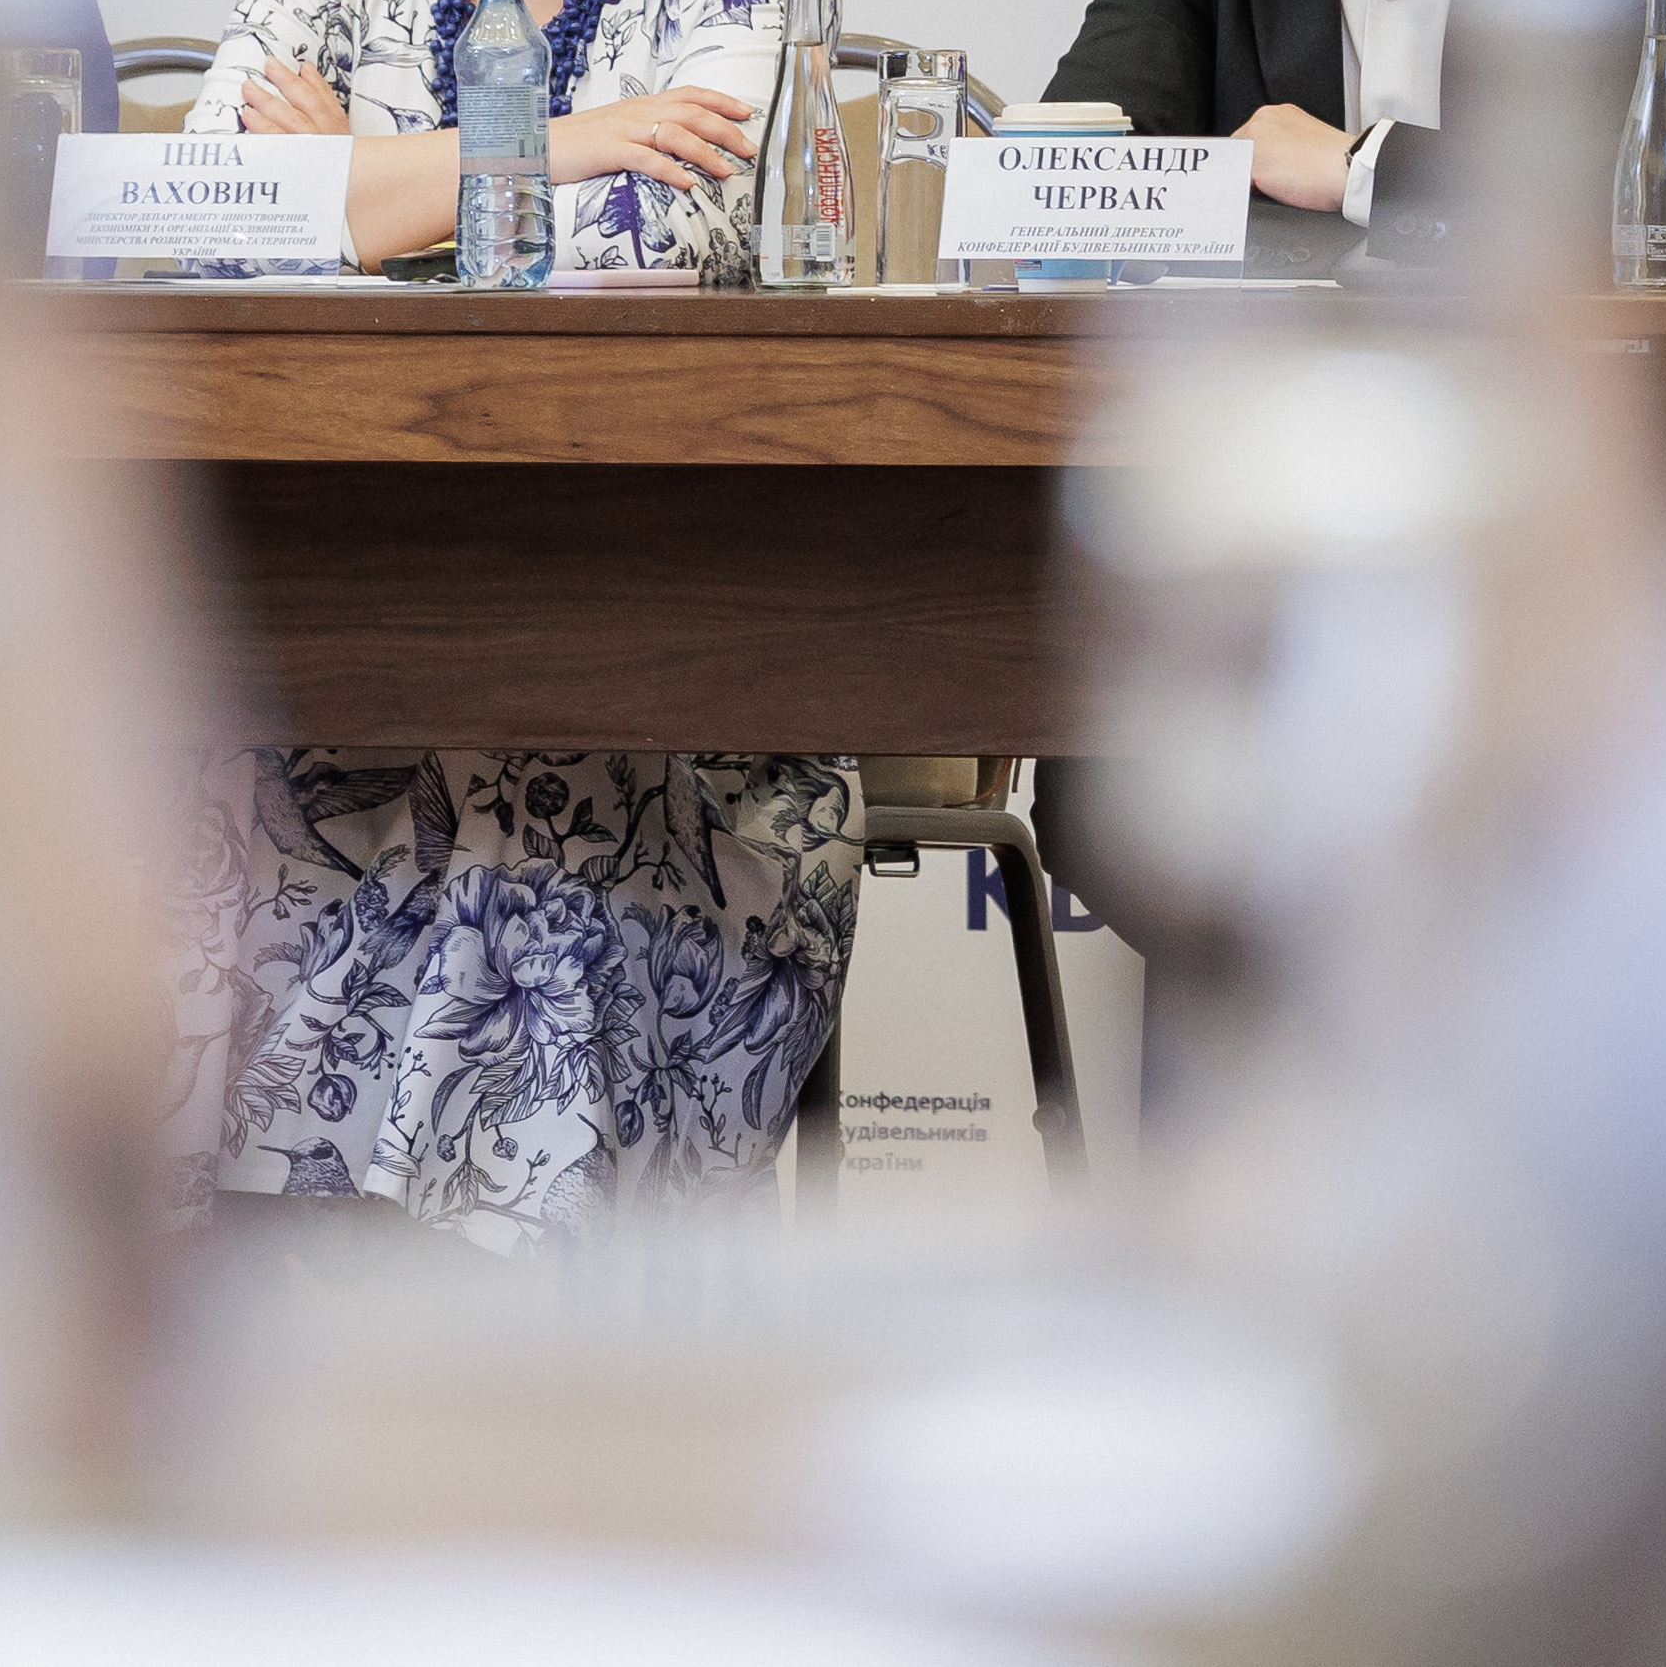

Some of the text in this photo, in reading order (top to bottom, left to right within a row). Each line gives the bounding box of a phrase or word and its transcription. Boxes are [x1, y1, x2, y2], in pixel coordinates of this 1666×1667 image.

[163, 143, 244, 167] ІННА
[998, 146, 1210, 175] ОЛЕКСАНДР
[120, 180, 281, 206] ВАХОВИЧ
[1033, 185, 1167, 211] ЧЕРВАК
[149, 236, 200, 245] РОЗВИТКУ
[1010, 225, 1184, 239] ГЕНЕРАЛЬНИЙ ДИРЕКТОР
[171, 246, 217, 256] УКРАЇНИ
[957, 241, 1235, 254] КОНФЕДЕРАЦІЇ БУДІВЕЛЬНИКІВ УКРАЇНИ
[845, 1152, 923, 1175] країни
